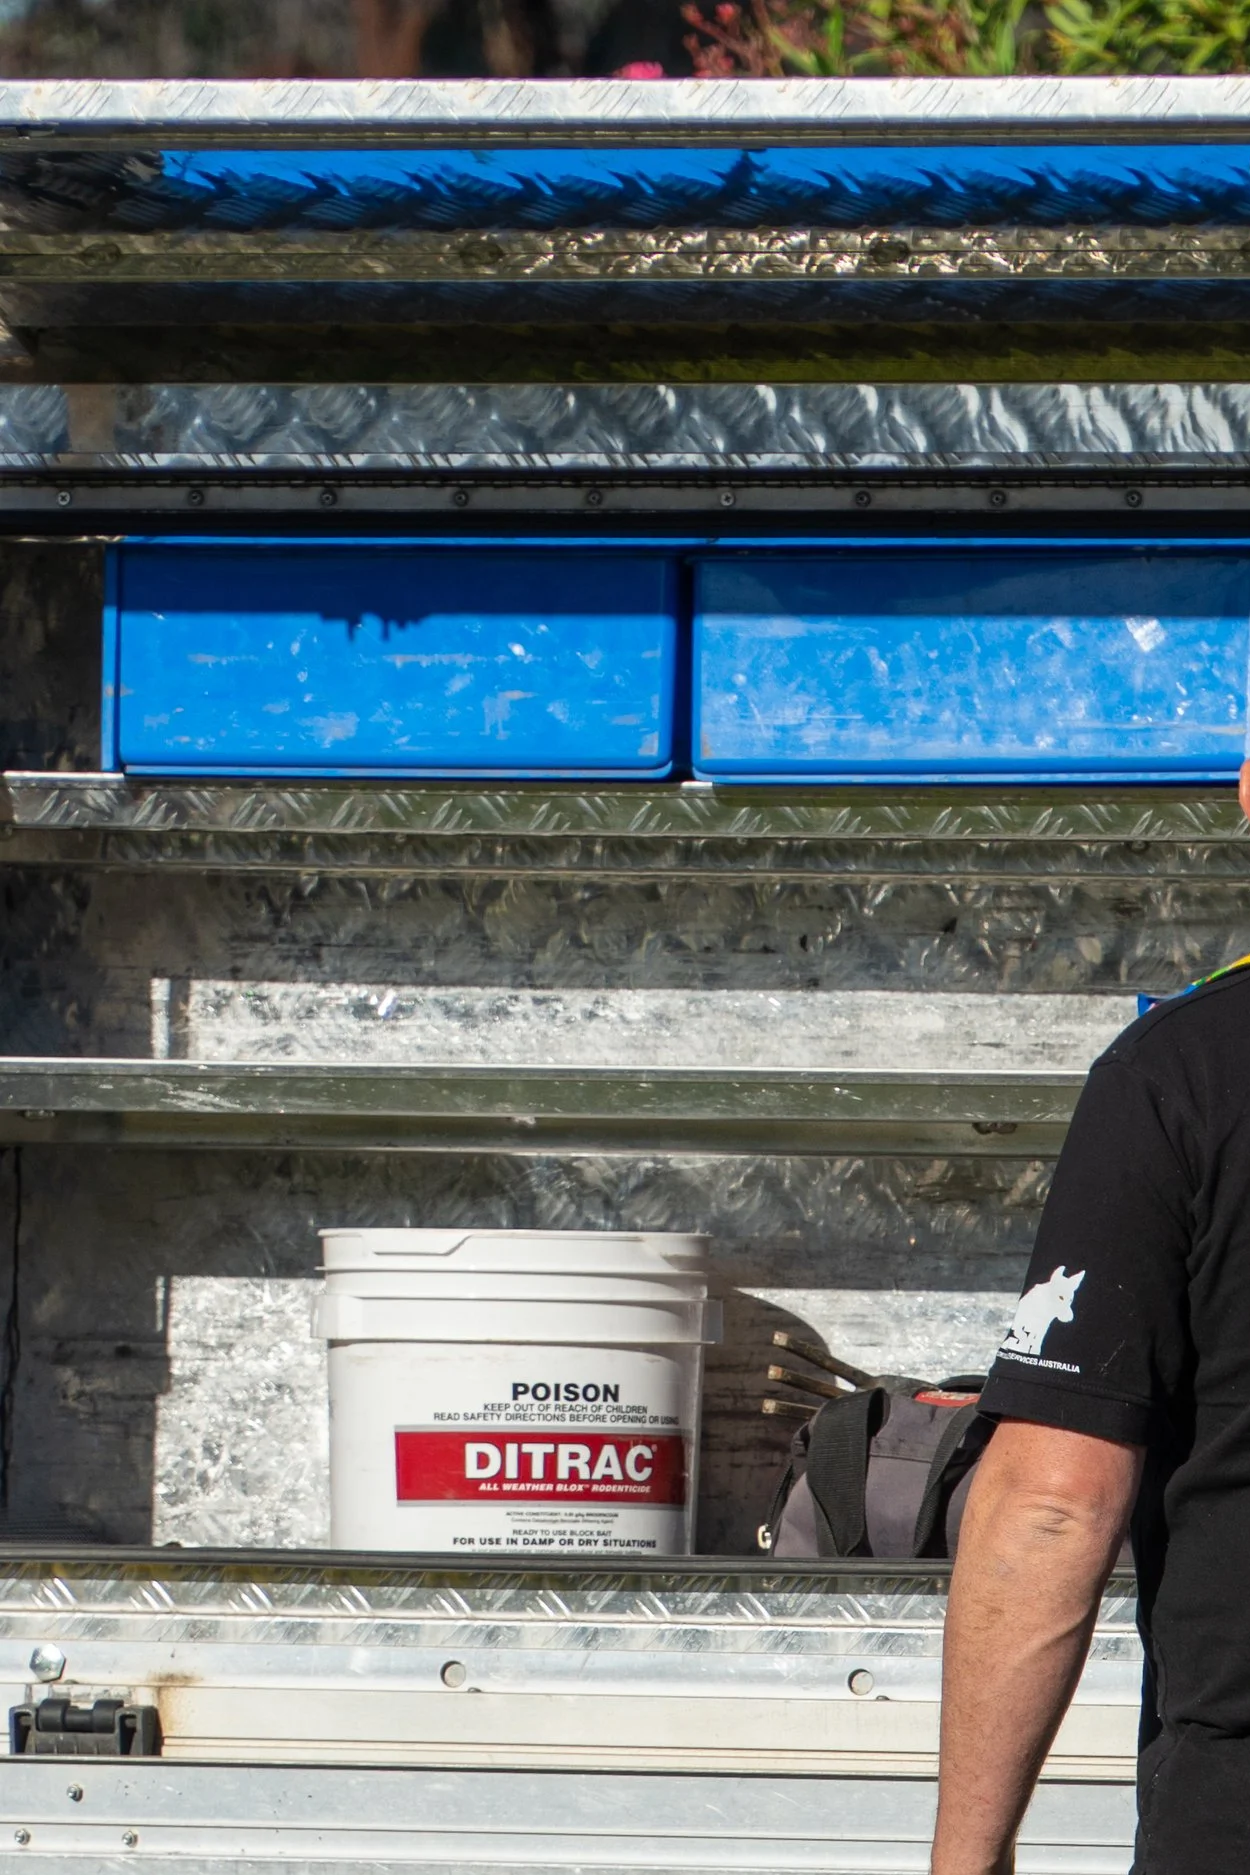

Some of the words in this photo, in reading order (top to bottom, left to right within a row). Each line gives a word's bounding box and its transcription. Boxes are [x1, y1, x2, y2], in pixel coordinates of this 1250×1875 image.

[1038, 1359, 1080, 1373] AUSTRALIA
[512, 1382, 620, 1403] POISON
[483, 1403, 511, 1412] KEEP
[513, 1403, 535, 1412] OUT
[537, 1404, 551, 1412] OF
[554, 1404, 588, 1413] REACH
[590, 1404, 603, 1413] OF
[605, 1405, 648, 1414] CHILDREN
[433, 1412, 460, 1421] READ
[463, 1412, 502, 1421] SAFETY
[504, 1412, 566, 1422] DIRECTIONS
[569, 1413, 607, 1422] BEFORE
[609, 1414, 647, 1424] OPENING
[648, 1415, 659, 1424] OR
[660, 1416, 679, 1425] USING
[478, 1482, 500, 1492] ALL
[502, 1483, 554, 1492] WEATHER
[591, 1484, 651, 1494] RODENTICIDE
[453, 1537, 475, 1546] FOR
[479, 1537, 502, 1546] USE
[506, 1537, 518, 1546] IN
[522, 1537, 555, 1546] DAMP
[558, 1538, 574, 1546] OR
[578, 1538, 599, 1547] DRY
[603, 1539, 657, 1548] SITUATIONS
